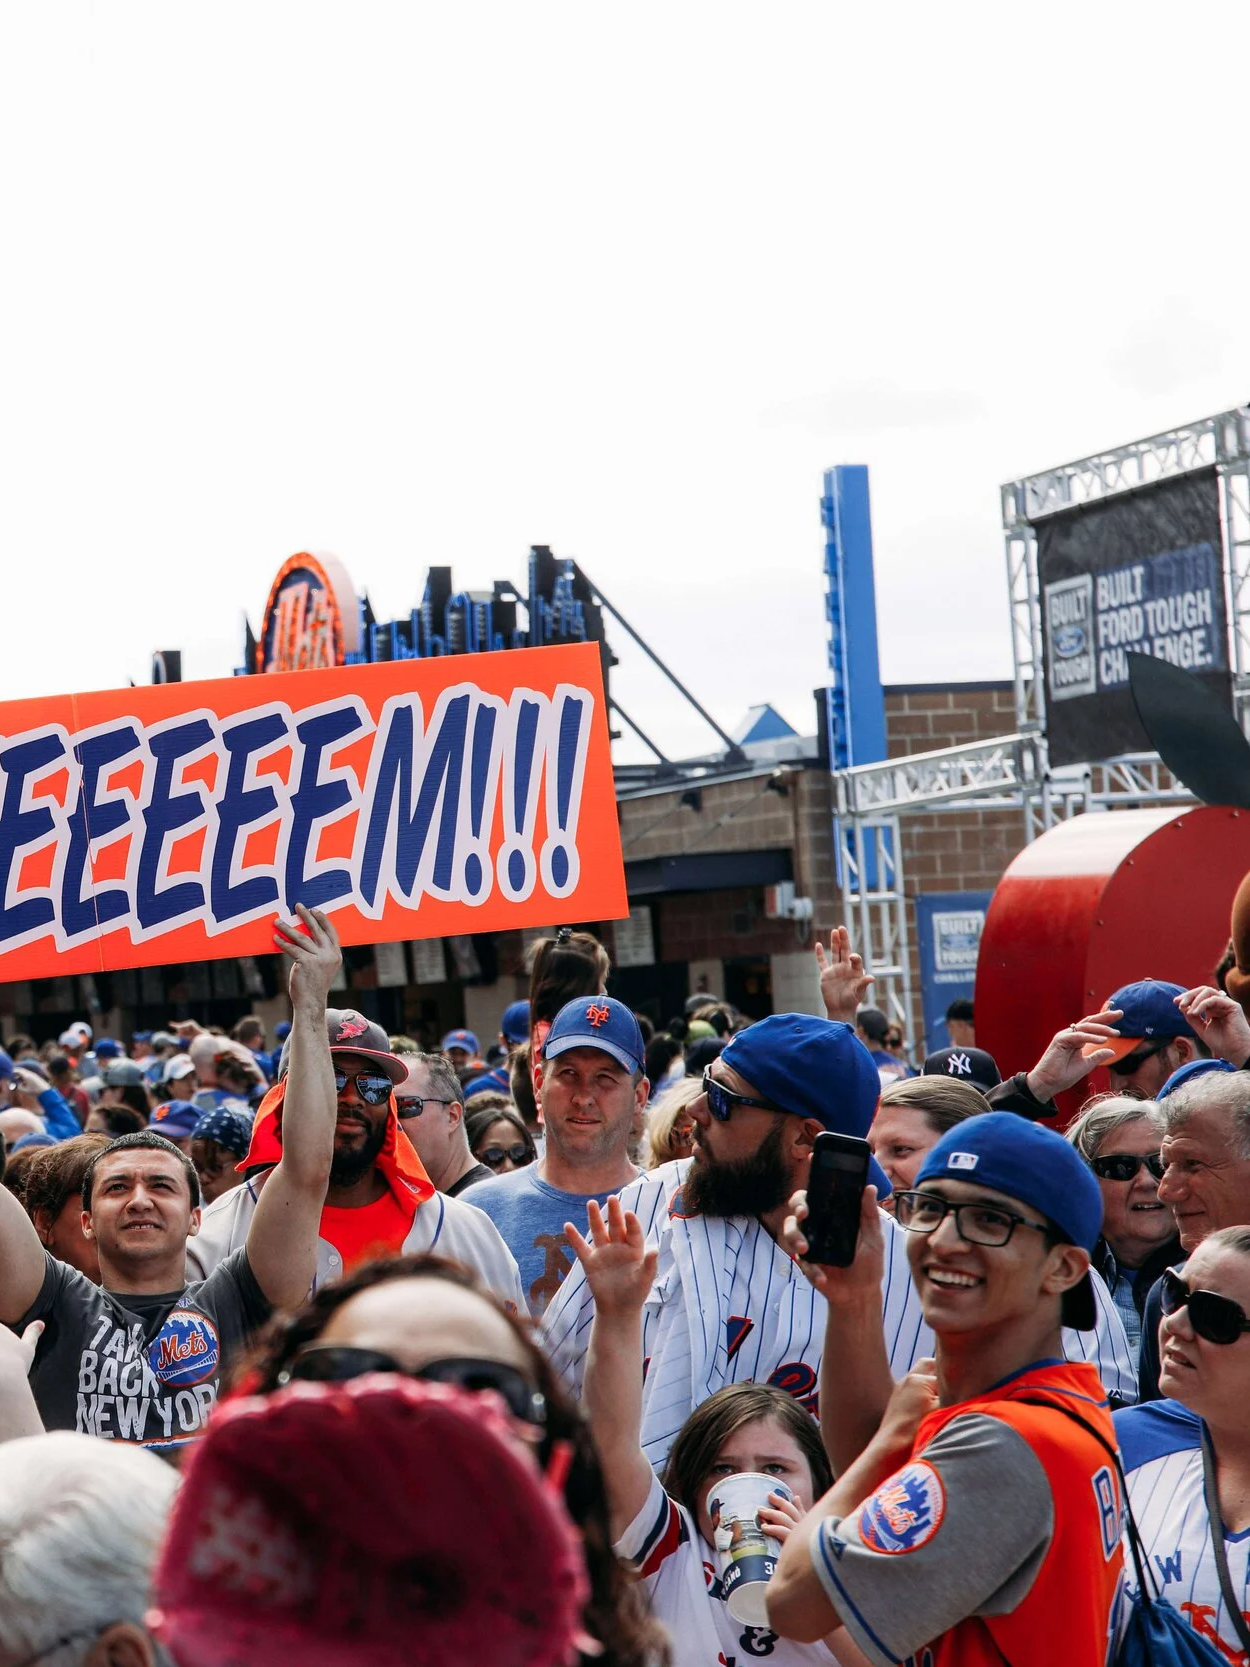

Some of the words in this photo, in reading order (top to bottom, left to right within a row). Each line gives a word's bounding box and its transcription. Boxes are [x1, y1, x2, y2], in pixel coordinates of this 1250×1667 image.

[1051, 590, 1087, 626] BUILT
[1097, 565, 1144, 611] BUILT
[1097, 606, 1144, 648] FORD
[1144, 589, 1212, 637] TOUGH
[1099, 629, 1212, 685] CHAENGE.
[586, 1003, 610, 1027] NY
[948, 1053, 972, 1074] NY
[158, 1331, 207, 1370] Mets
[78, 1350, 160, 1398] BACK
[75, 1393, 150, 1440] NEW
[154, 1378, 220, 1438] YOR
